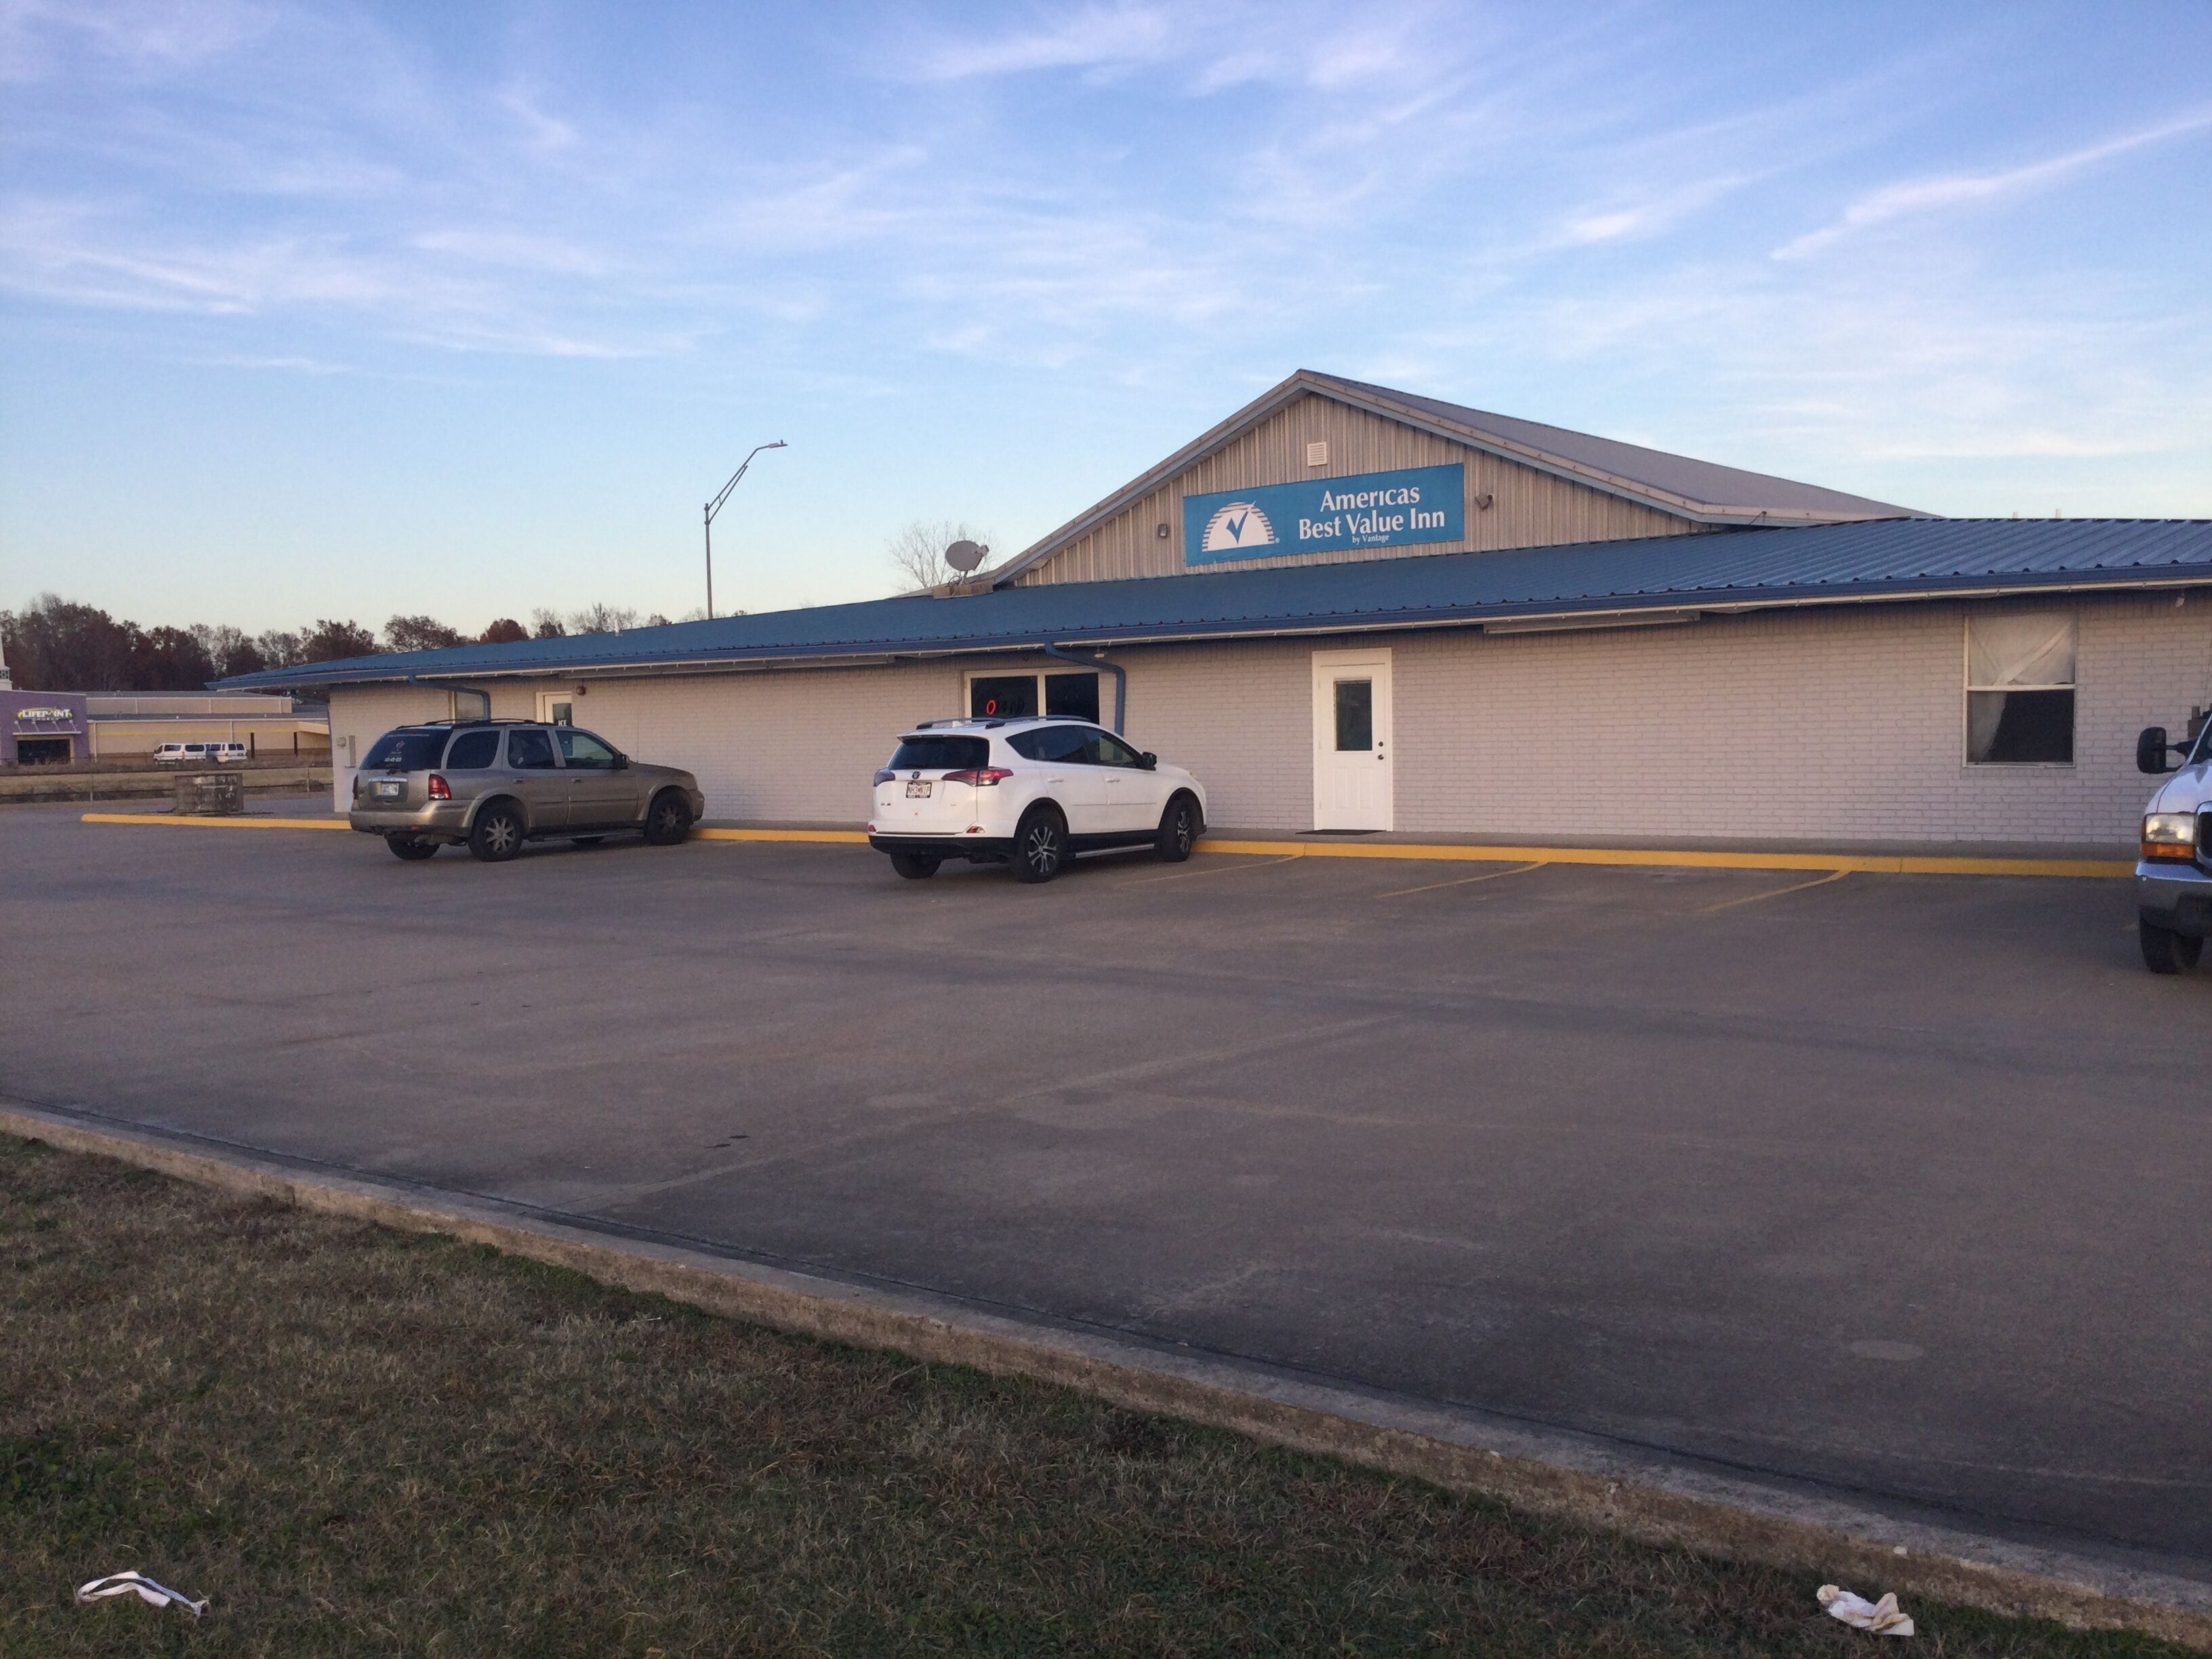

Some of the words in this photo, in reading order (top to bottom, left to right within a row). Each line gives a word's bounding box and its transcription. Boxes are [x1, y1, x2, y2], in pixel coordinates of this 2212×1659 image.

[1319, 487, 1420, 512] Americas
[1298, 516, 1342, 540] Best
[1345, 509, 1404, 535] Value
[1410, 508, 1445, 530] Inn
[1352, 535, 1360, 546] by
[1361, 534, 1390, 544] Vantage
